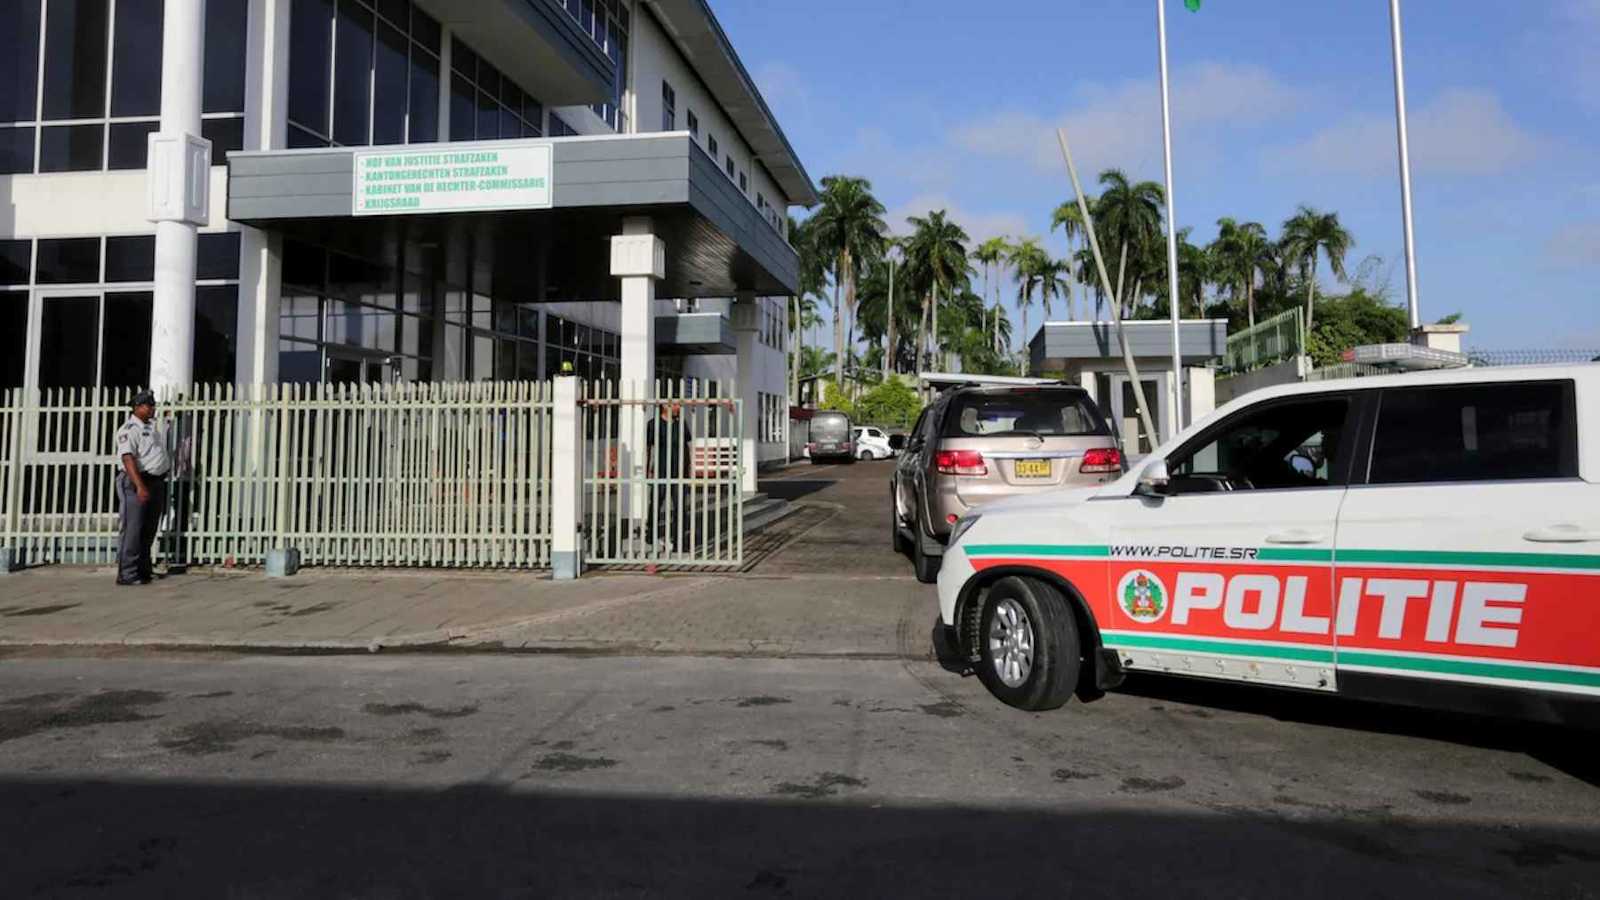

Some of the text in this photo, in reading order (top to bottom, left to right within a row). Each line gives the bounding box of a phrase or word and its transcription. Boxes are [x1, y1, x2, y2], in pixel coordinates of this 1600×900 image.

[366, 152, 497, 167] HOF VAN JUSTITIE STRAFZAKEN
[366, 166, 507, 180] KANTONGERECHTEN STRAFZAKEN
[366, 184, 400, 194] KABINET
[404, 183, 421, 193] VAN
[423, 183, 434, 192] DE
[366, 197, 419, 208] KRIJGSRAAD
[1110, 546, 1257, 559] WWW.POLITIE.SR
[1171, 572, 1527, 648] POLITIE
